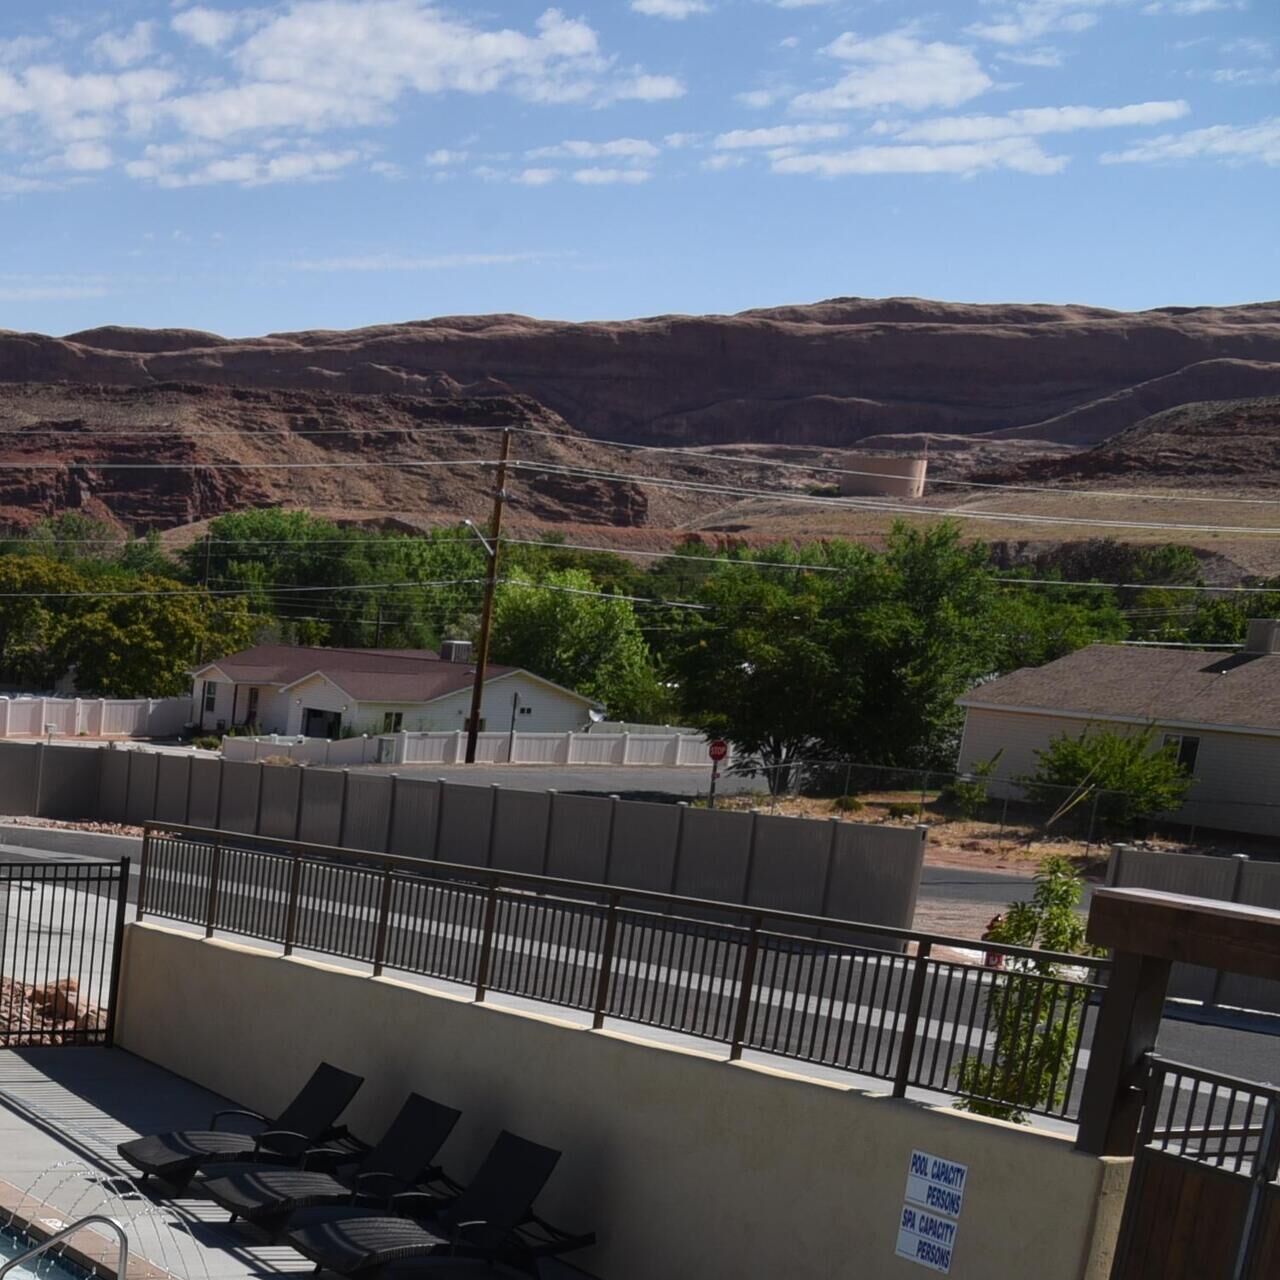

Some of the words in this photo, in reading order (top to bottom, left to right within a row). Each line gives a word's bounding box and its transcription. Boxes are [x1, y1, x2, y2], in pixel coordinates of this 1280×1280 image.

[711, 745, 727, 755] STOP
[911, 1153, 929, 1177] POOL
[931, 1161, 966, 1188] CAPACITY
[926, 1185, 961, 1215] PERSONS
[902, 1208, 917, 1231] SPA
[918, 1214, 955, 1244] CAPACITY
[916, 1239, 951, 1269] PERSONS
